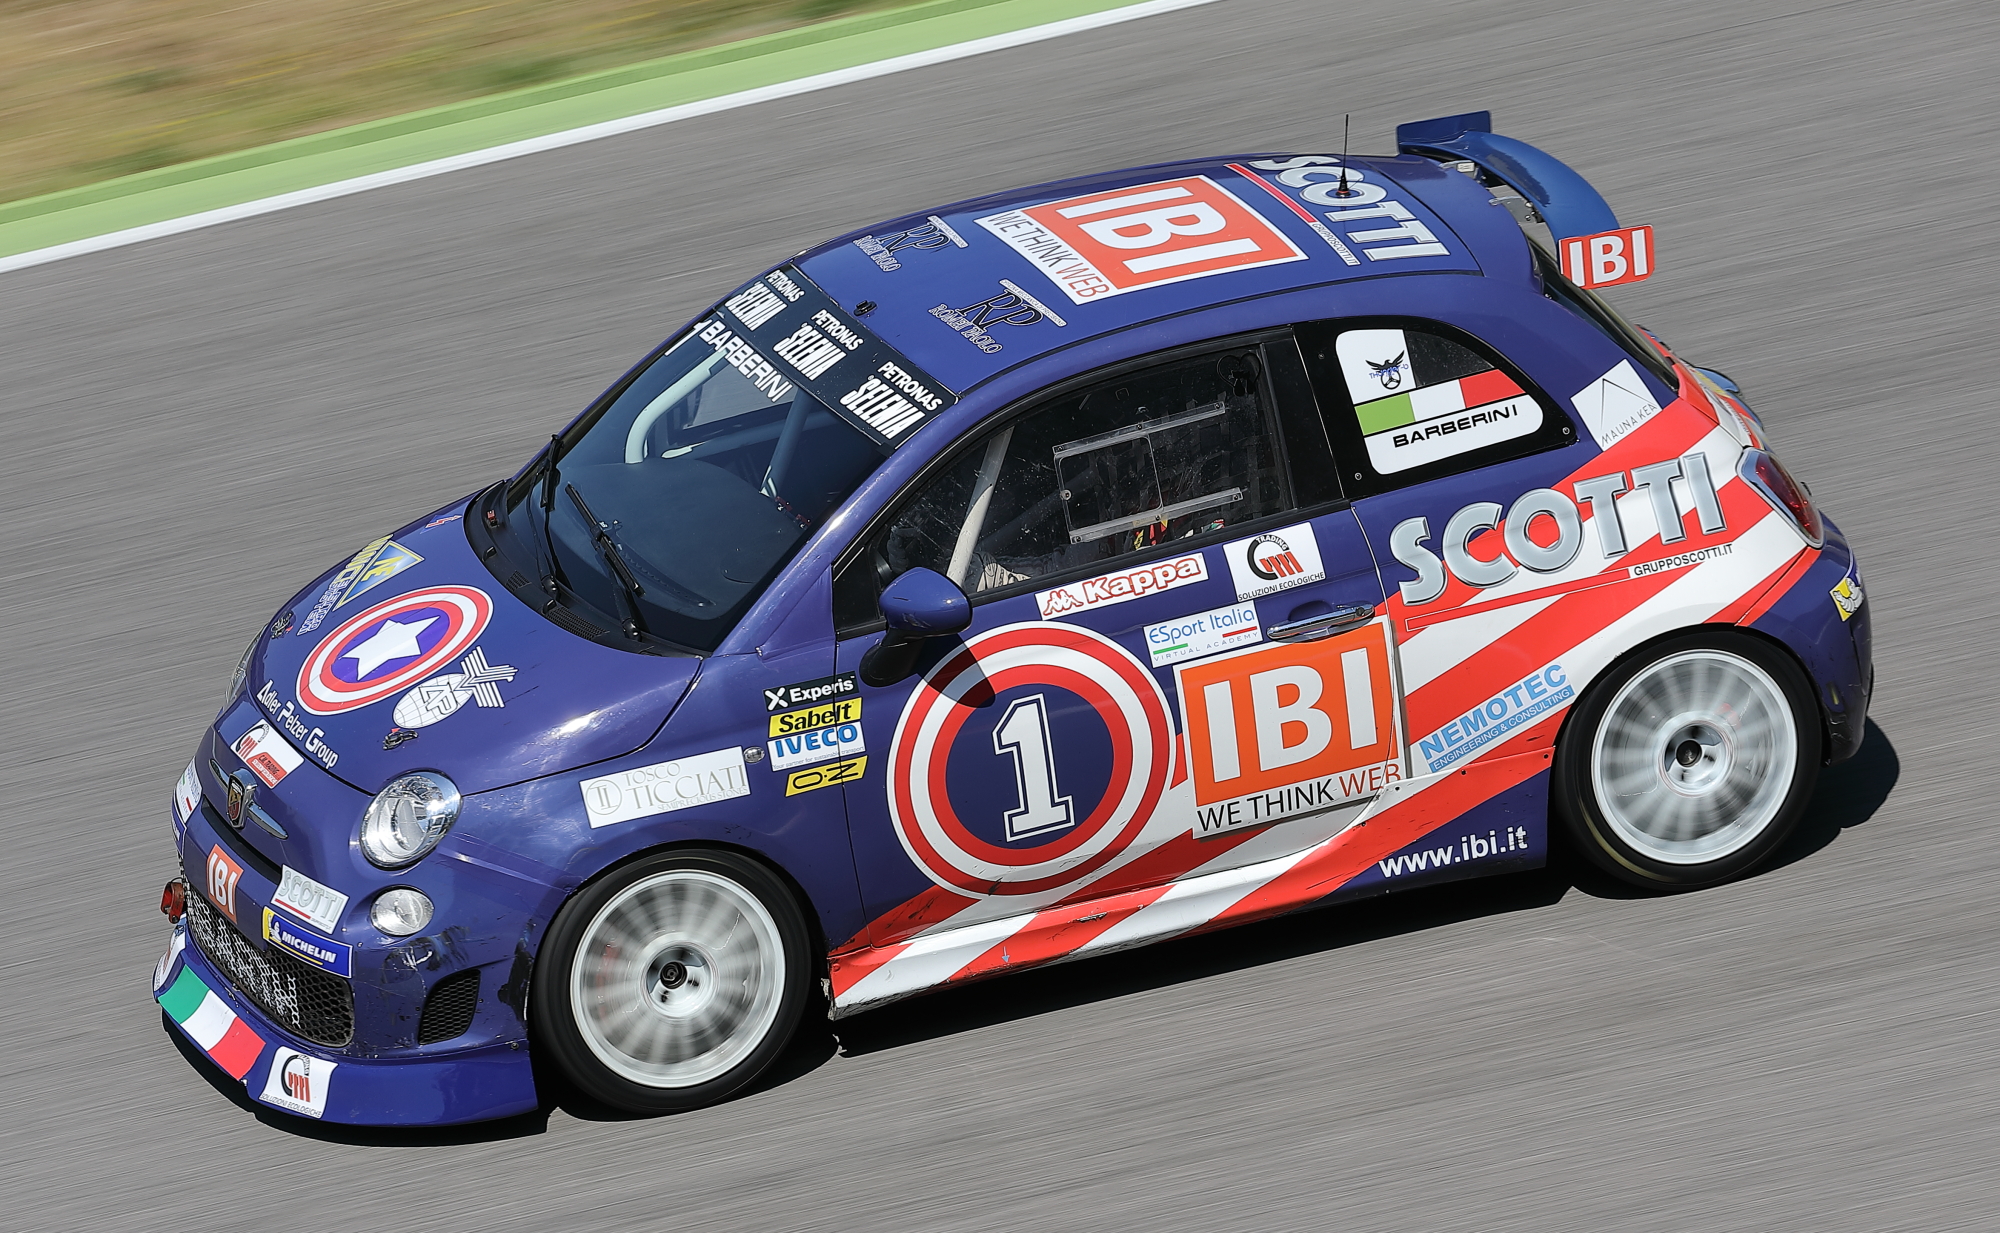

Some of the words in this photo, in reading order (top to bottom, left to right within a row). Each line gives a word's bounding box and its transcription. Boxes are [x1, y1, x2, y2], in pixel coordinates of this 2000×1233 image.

[1055, 186, 1262, 274] IBI
[1248, 155, 1450, 262] SCOTTI
[987, 211, 1018, 233] WE
[1011, 227, 1078, 268] THINK
[1055, 262, 1110, 297] WEB
[1311, 223, 1359, 265] GRUPPOSCOTTI.IT
[1569, 229, 1648, 287] IBI
[724, 280, 788, 331] SELENIA
[764, 269, 805, 302] PETRONAS
[772, 321, 847, 381] SELENIA
[810, 309, 863, 351] PETRONAS
[960, 326, 1003, 354] PAOLO
[698, 320, 794, 402] BARBERINI
[840, 375, 926, 440] SELENIA
[877, 361, 943, 412] PETRONAS
[1392, 404, 1518, 448] BARBERINI
[1601, 415, 1638, 448] MAUNA
[1636, 403, 1658, 420] KEA
[1256, 534, 1289, 551] TRADING
[1389, 451, 1727, 606] SCOTTI
[1082, 557, 1201, 604] Kappa
[1633, 543, 1733, 577] GRUPPOSCOTTI.IT
[1238, 585, 1278, 601] SOLUZIONI
[1278, 571, 1325, 590] ECOLOGICHE
[1210, 607, 1255, 632] Italia
[1153, 645, 1201, 662] VIRTUAL
[1206, 631, 1259, 650] ACADEMY
[789, 679, 854, 703] Experis
[1203, 647, 1378, 784] IBI
[1419, 663, 1567, 762] NEMOTEC
[256, 679, 281, 714] Adler
[277, 701, 309, 741] Pelzer
[305, 727, 339, 769] Group
[775, 724, 858, 758] IVECO
[778, 702, 852, 733] Sabelt
[1434, 728, 1499, 772] ENGINEERING
[1499, 721, 1508, 732] &
[1508, 686, 1571, 728] CONSULTING
[621, 762, 681, 787] TOSCO
[625, 764, 747, 809] TICCIATI
[992, 693, 1075, 843] 1
[657, 793, 717, 812] SEMIPRECIOUS
[717, 786, 748, 800] STONES
[1197, 799, 1243, 832] WE
[1246, 778, 1334, 823] THINK
[1338, 762, 1401, 799] WEB
[1377, 825, 1529, 879] www.ibi.it
[207, 851, 237, 915] IBI
[278, 869, 345, 924] SCOTTI
[282, 931, 337, 963] MICHELIN
